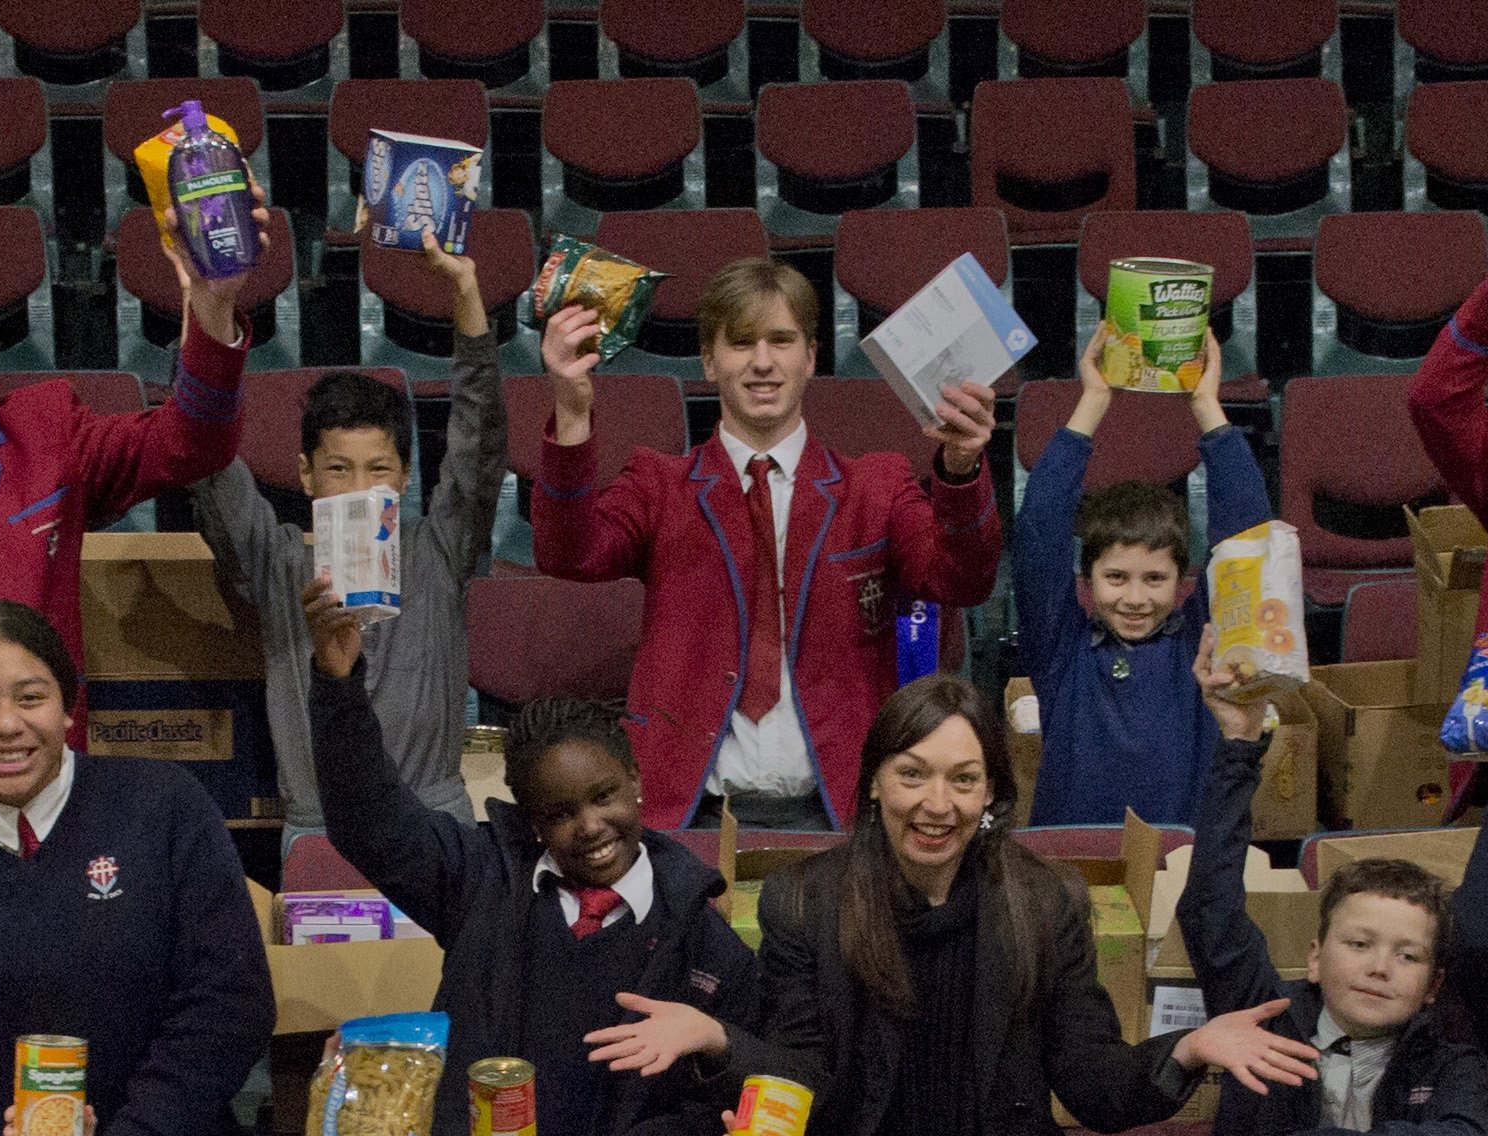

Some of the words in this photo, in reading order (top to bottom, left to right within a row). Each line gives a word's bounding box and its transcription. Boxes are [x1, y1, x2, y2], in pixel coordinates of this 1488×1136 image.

[187, 175, 234, 191] PALMOLIVE
[910, 599, 928, 624] 60
[90, 720, 148, 743] Pacific
[149, 719, 204, 743] Classic
